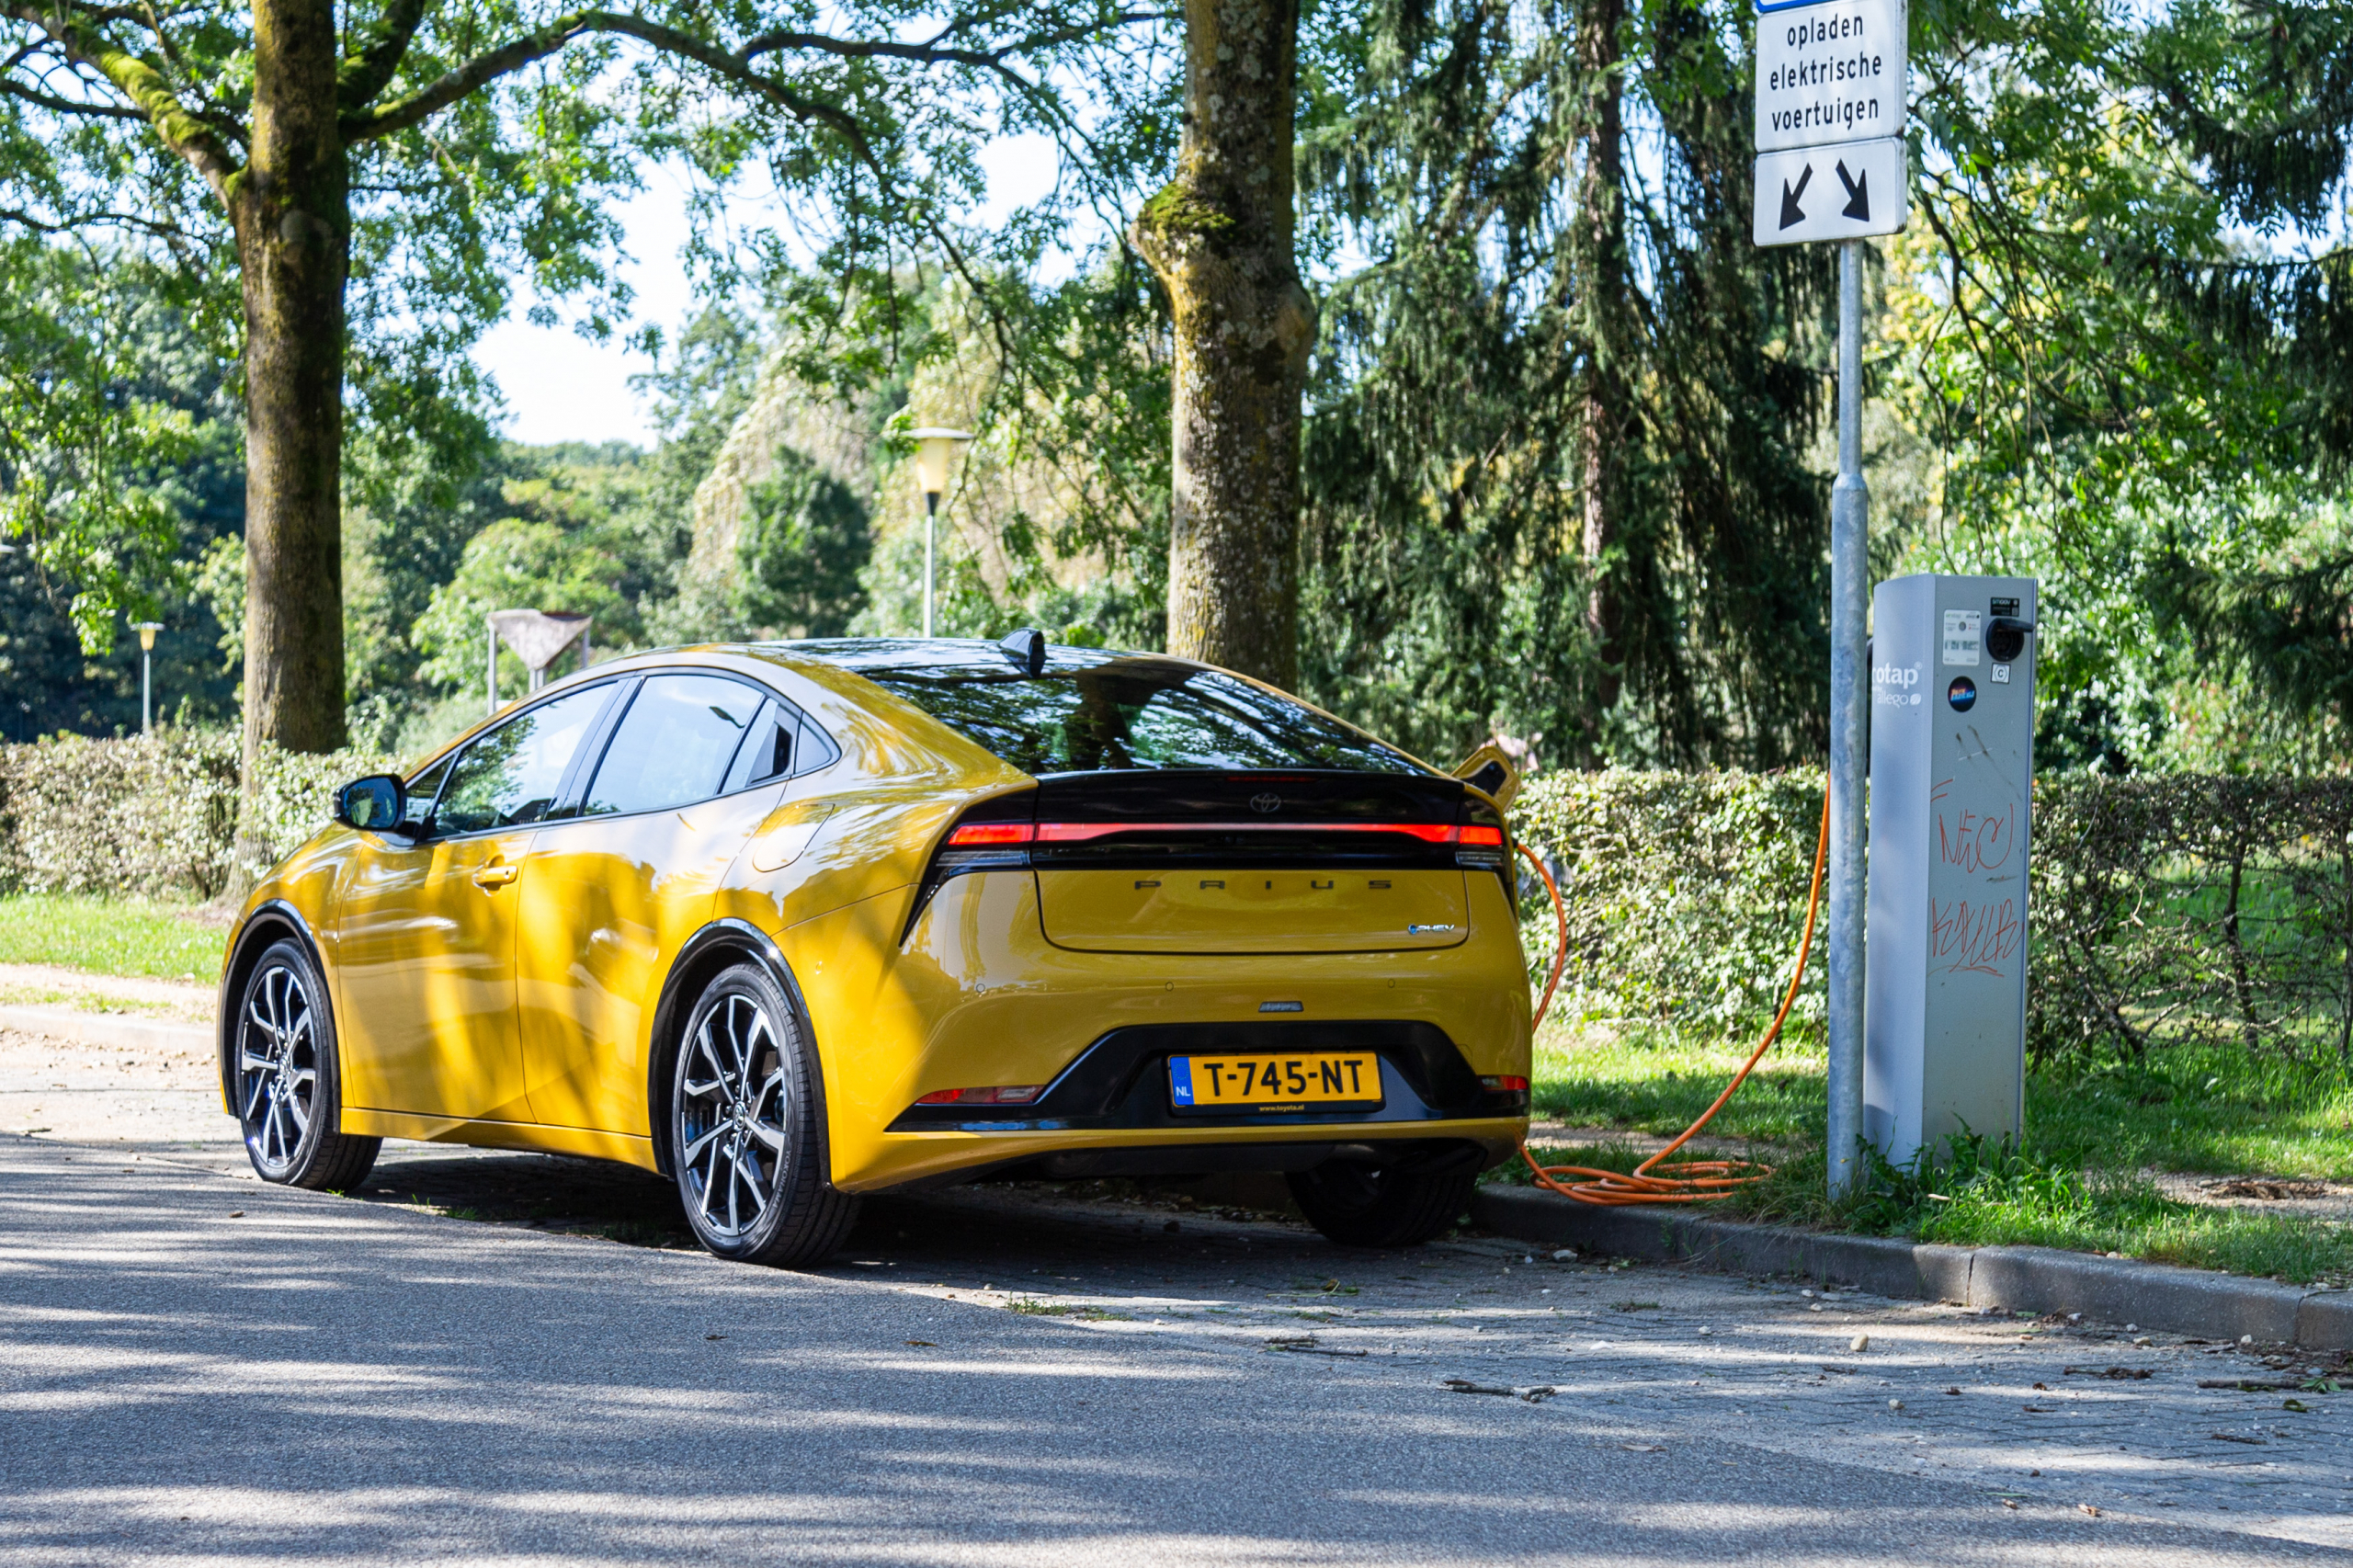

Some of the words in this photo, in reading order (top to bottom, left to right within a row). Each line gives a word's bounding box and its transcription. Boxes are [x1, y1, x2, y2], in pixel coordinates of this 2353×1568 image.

[1787, 14, 1863, 51] opladen
[1770, 51, 1881, 90] elektrische
[1772, 97, 1879, 131] voertuigen
[1997, 669, 2005, 678] C
[1877, 689, 1909, 709] allego
[1134, 880, 1392, 890] PRIUS
[1176, 1085, 1191, 1096] NL
[1203, 1060, 1363, 1096] T-745-NT
[1258, 1104, 1304, 1112] www.toyota.nl
[773, 1150, 791, 1209] YOKOHAMA
